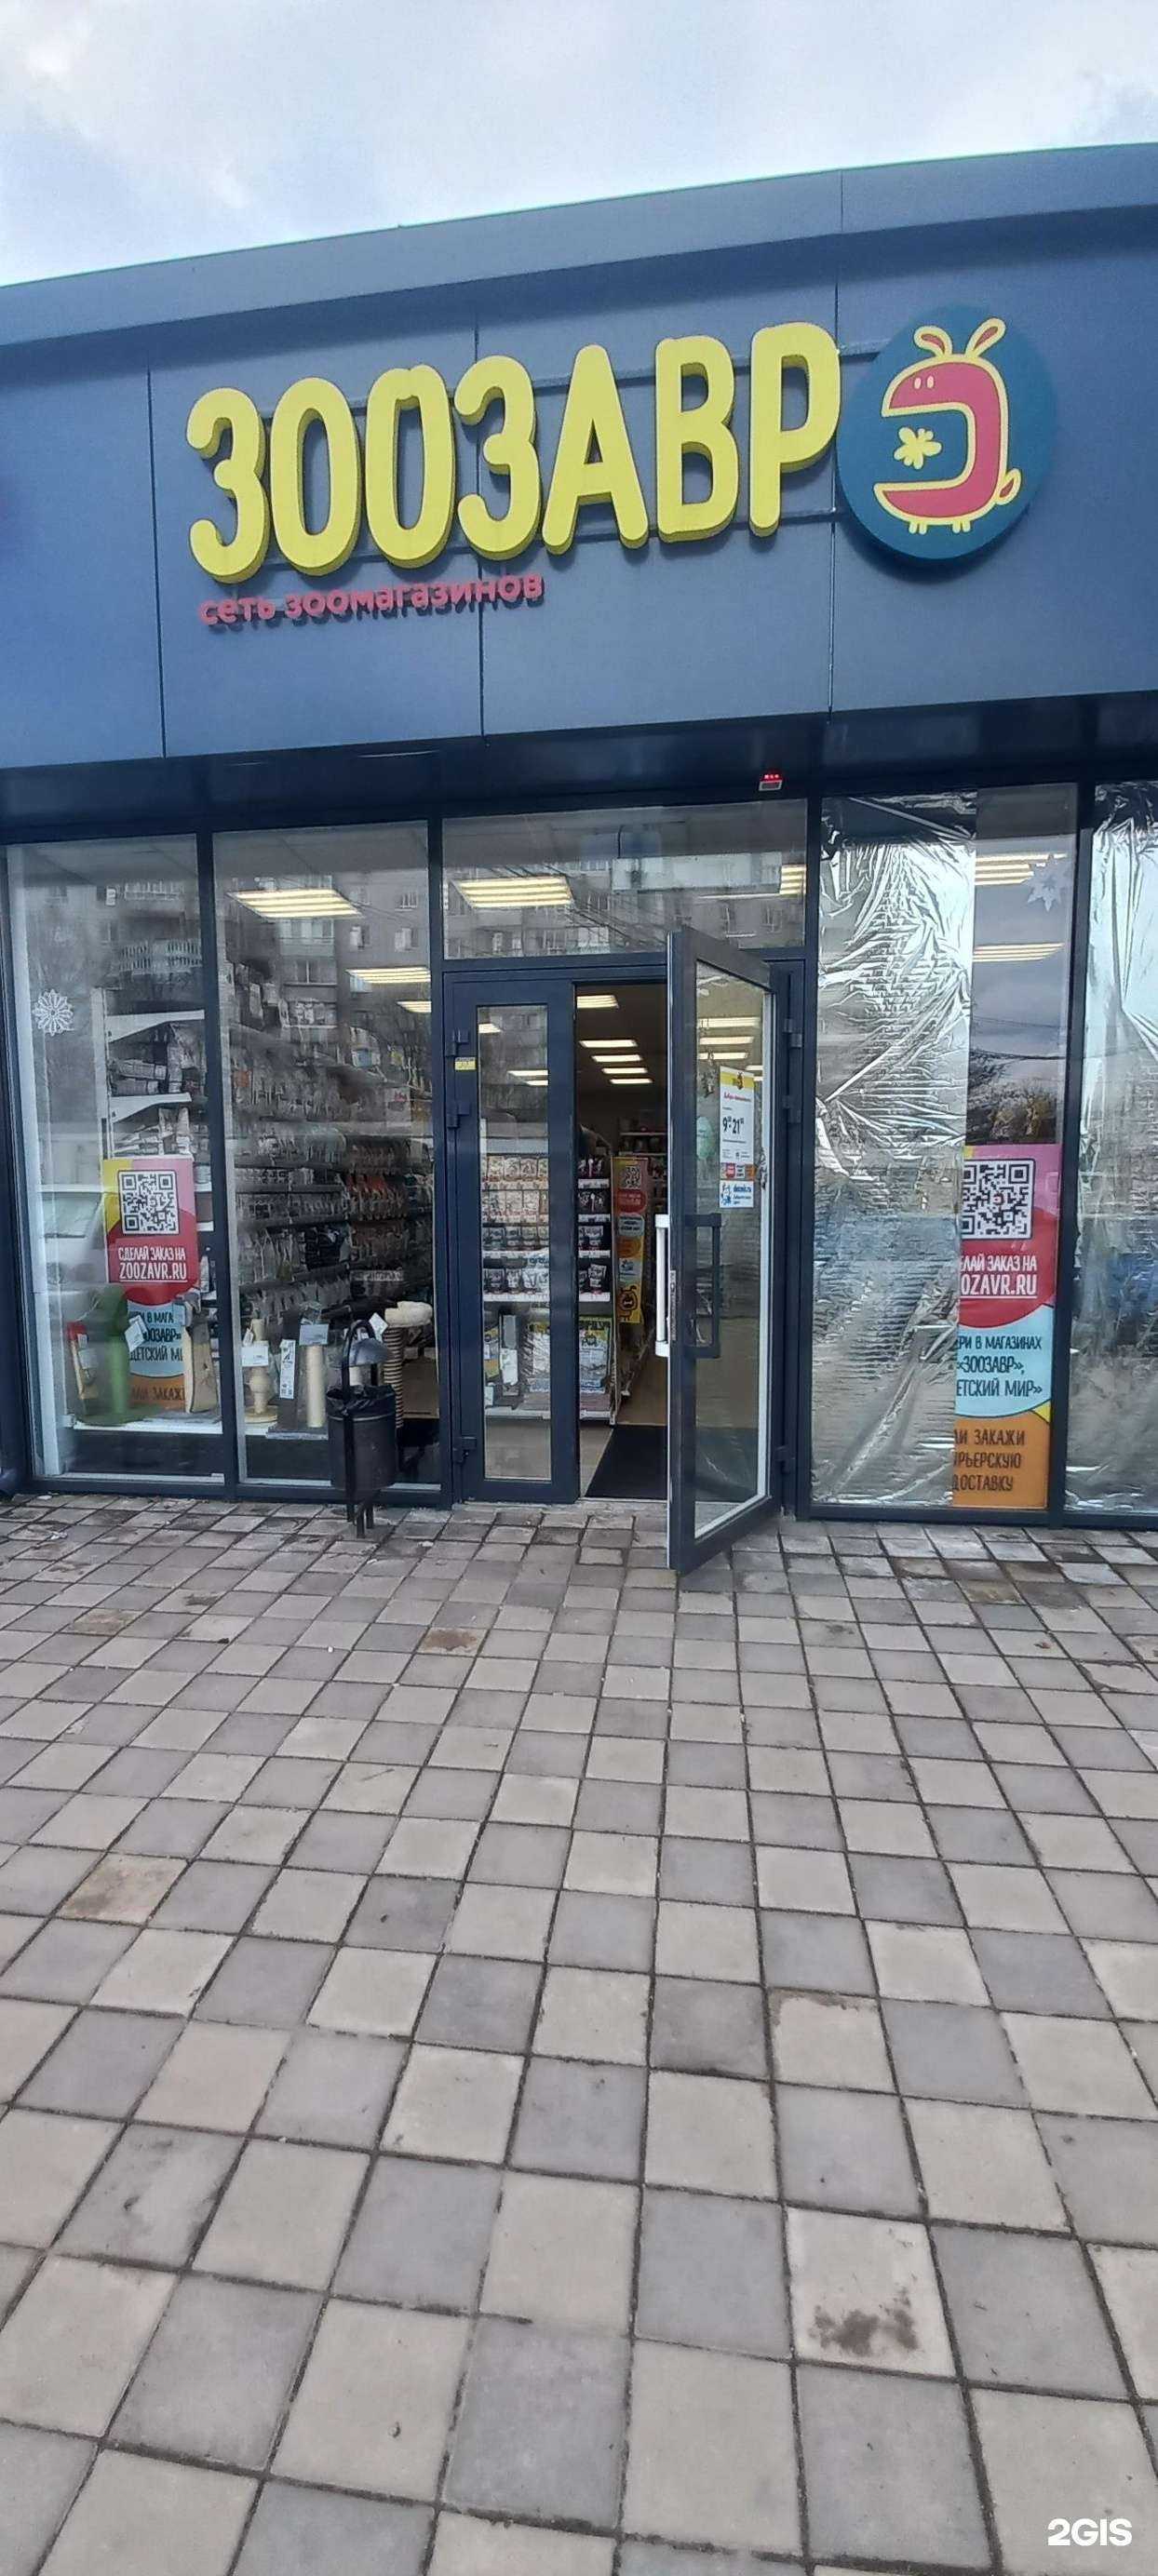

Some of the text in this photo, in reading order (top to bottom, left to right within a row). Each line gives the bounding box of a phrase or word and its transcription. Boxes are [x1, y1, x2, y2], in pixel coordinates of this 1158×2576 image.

[187, 321, 842, 584] ЗООЗАВР
[198, 572, 545, 625] сеть зоомагазинов
[117, 1245, 186, 1261] СДЕЛАЙ ЗАКАЗ НА
[119, 1262, 187, 1280] ZOOZAVR.RU
[987, 1254, 1021, 1272] ЗАКАЗ
[1022, 1254, 1037, 1272] НА
[976, 1335, 982, 1349] В
[985, 1335, 1043, 1349] МАГАЗИНАХ
[1004, 1380, 1043, 1397] МИР»
[974, 1429, 1026, 1445] ЗАКАЖИ
